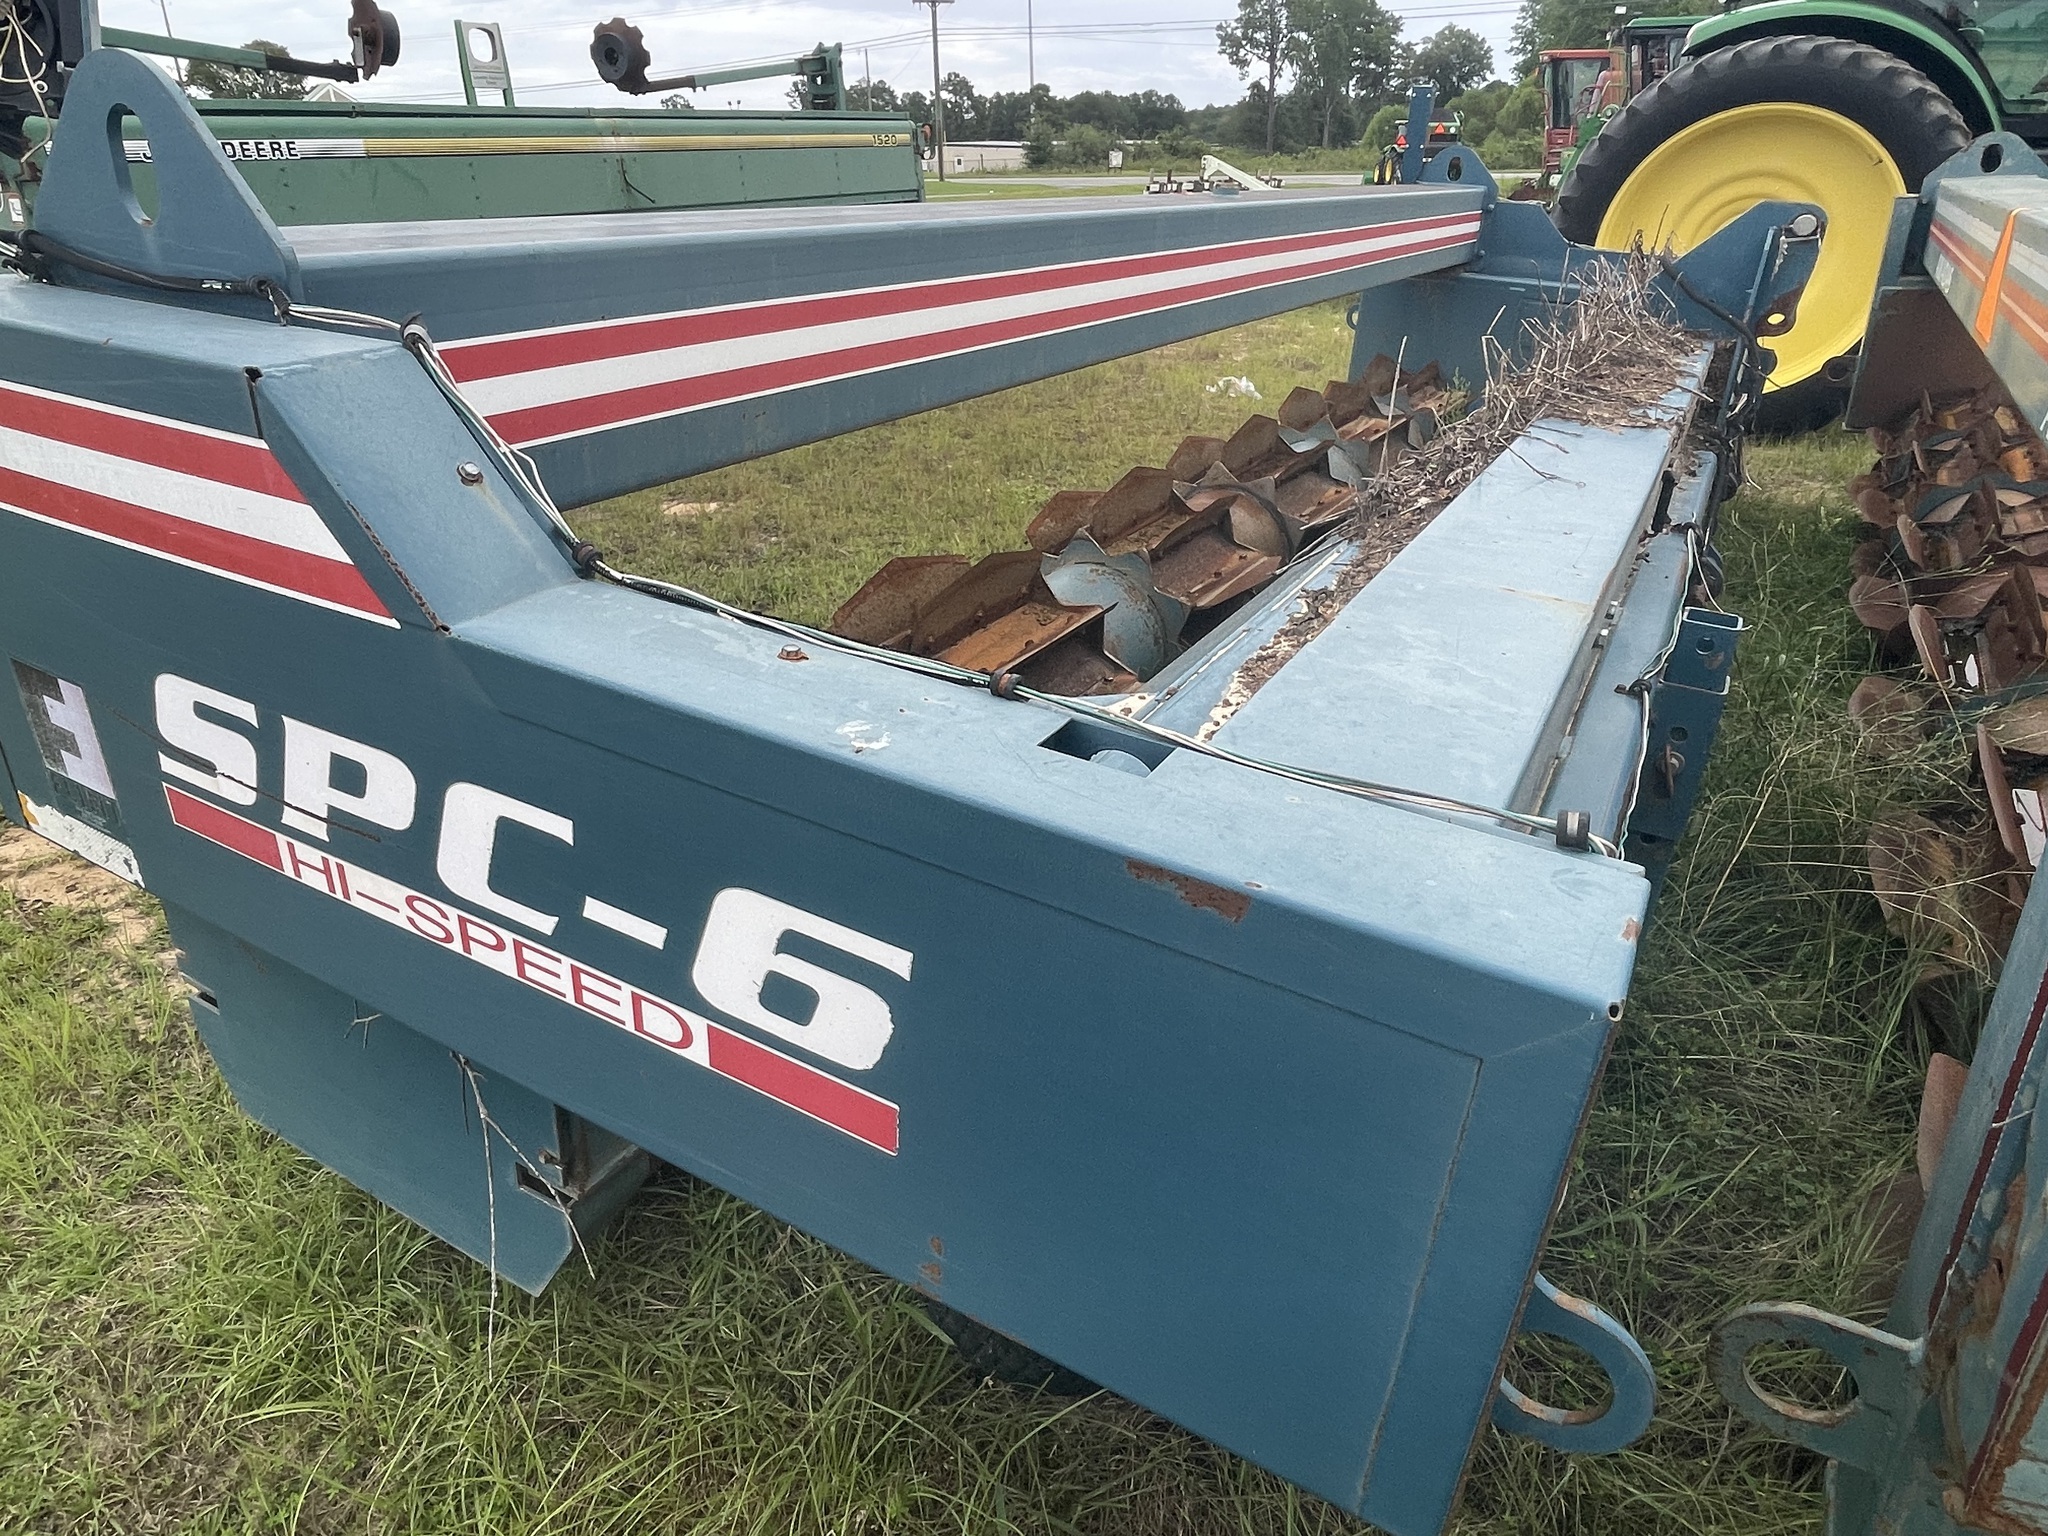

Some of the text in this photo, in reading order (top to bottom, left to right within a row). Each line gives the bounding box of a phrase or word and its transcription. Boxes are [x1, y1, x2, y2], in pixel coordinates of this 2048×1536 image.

[220, 140, 299, 160] DEERE
[872, 134, 898, 146] 1520
[155, 672, 914, 1071] SPC-6
[286, 840, 694, 1050] HI-SPEED
